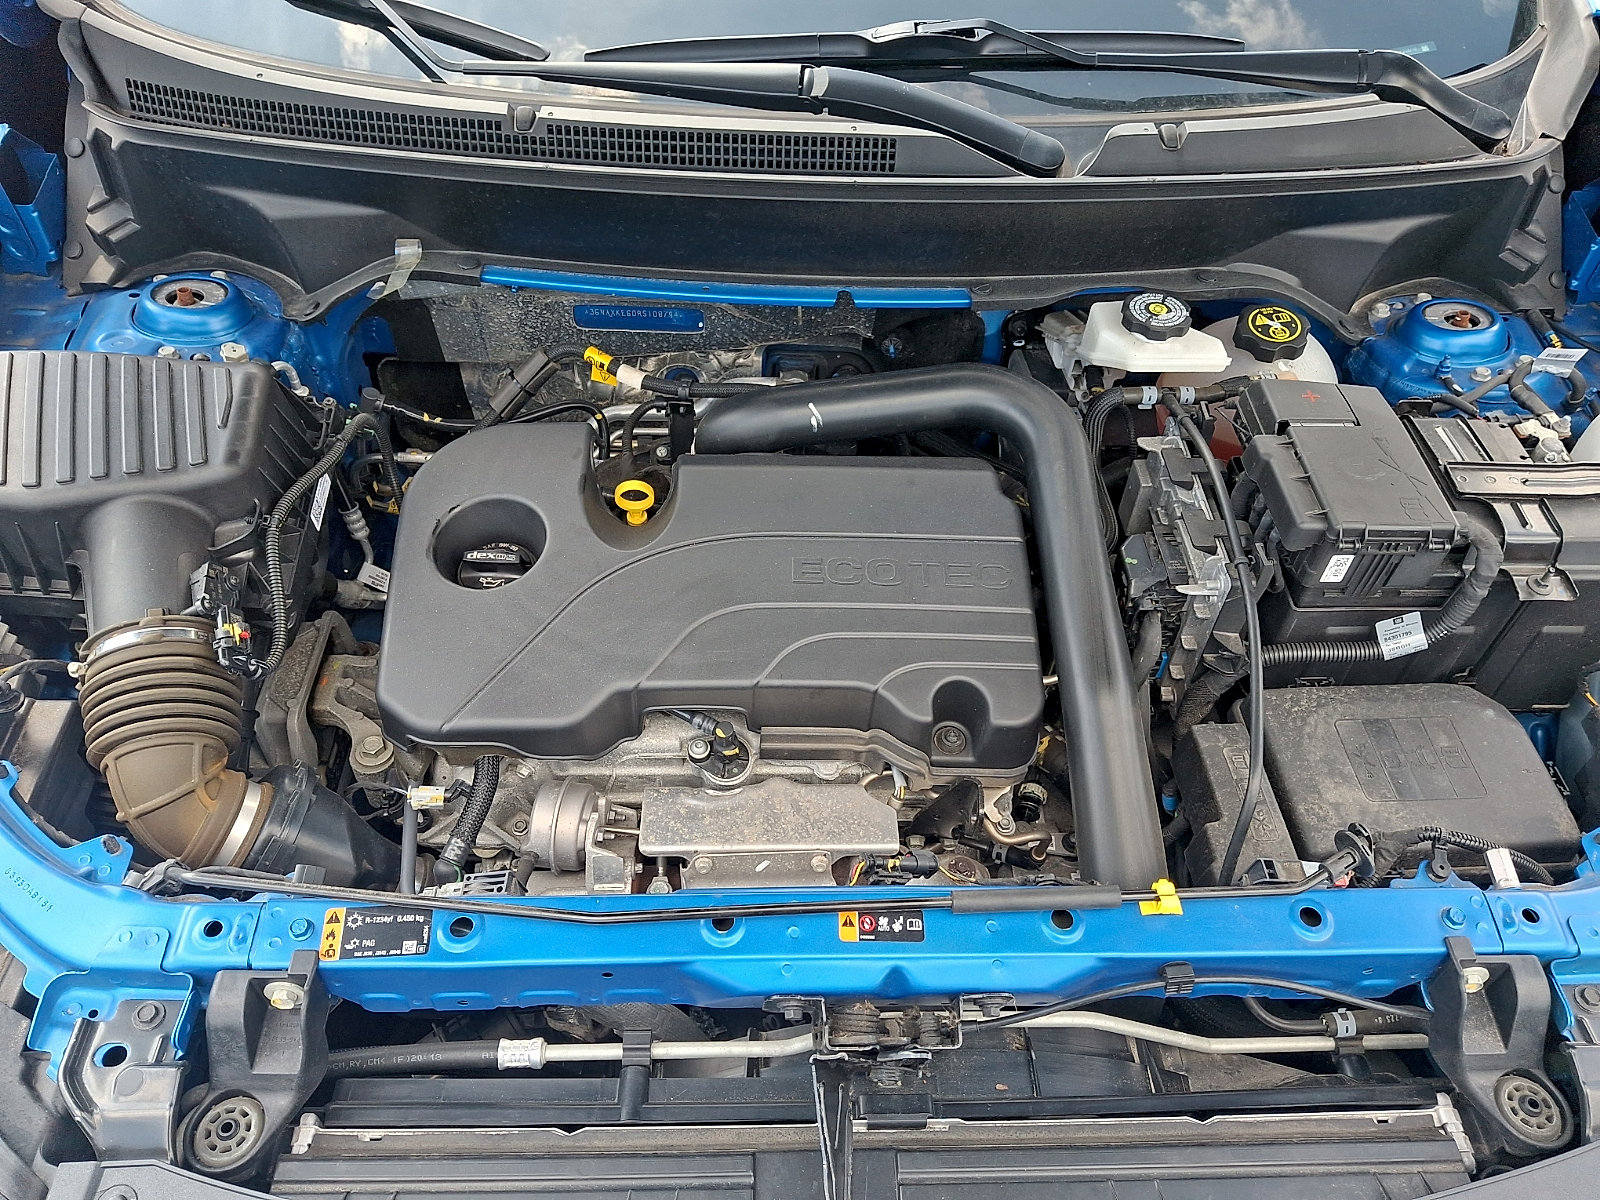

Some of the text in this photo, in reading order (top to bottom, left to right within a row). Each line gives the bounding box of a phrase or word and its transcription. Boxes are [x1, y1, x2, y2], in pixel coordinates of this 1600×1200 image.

[466, 551, 516, 561] dexos
[791, 556, 1012, 590] ECOTEC
[365, 915, 393, 923] R-1234yf
[361, 939, 376, 948] PAG
